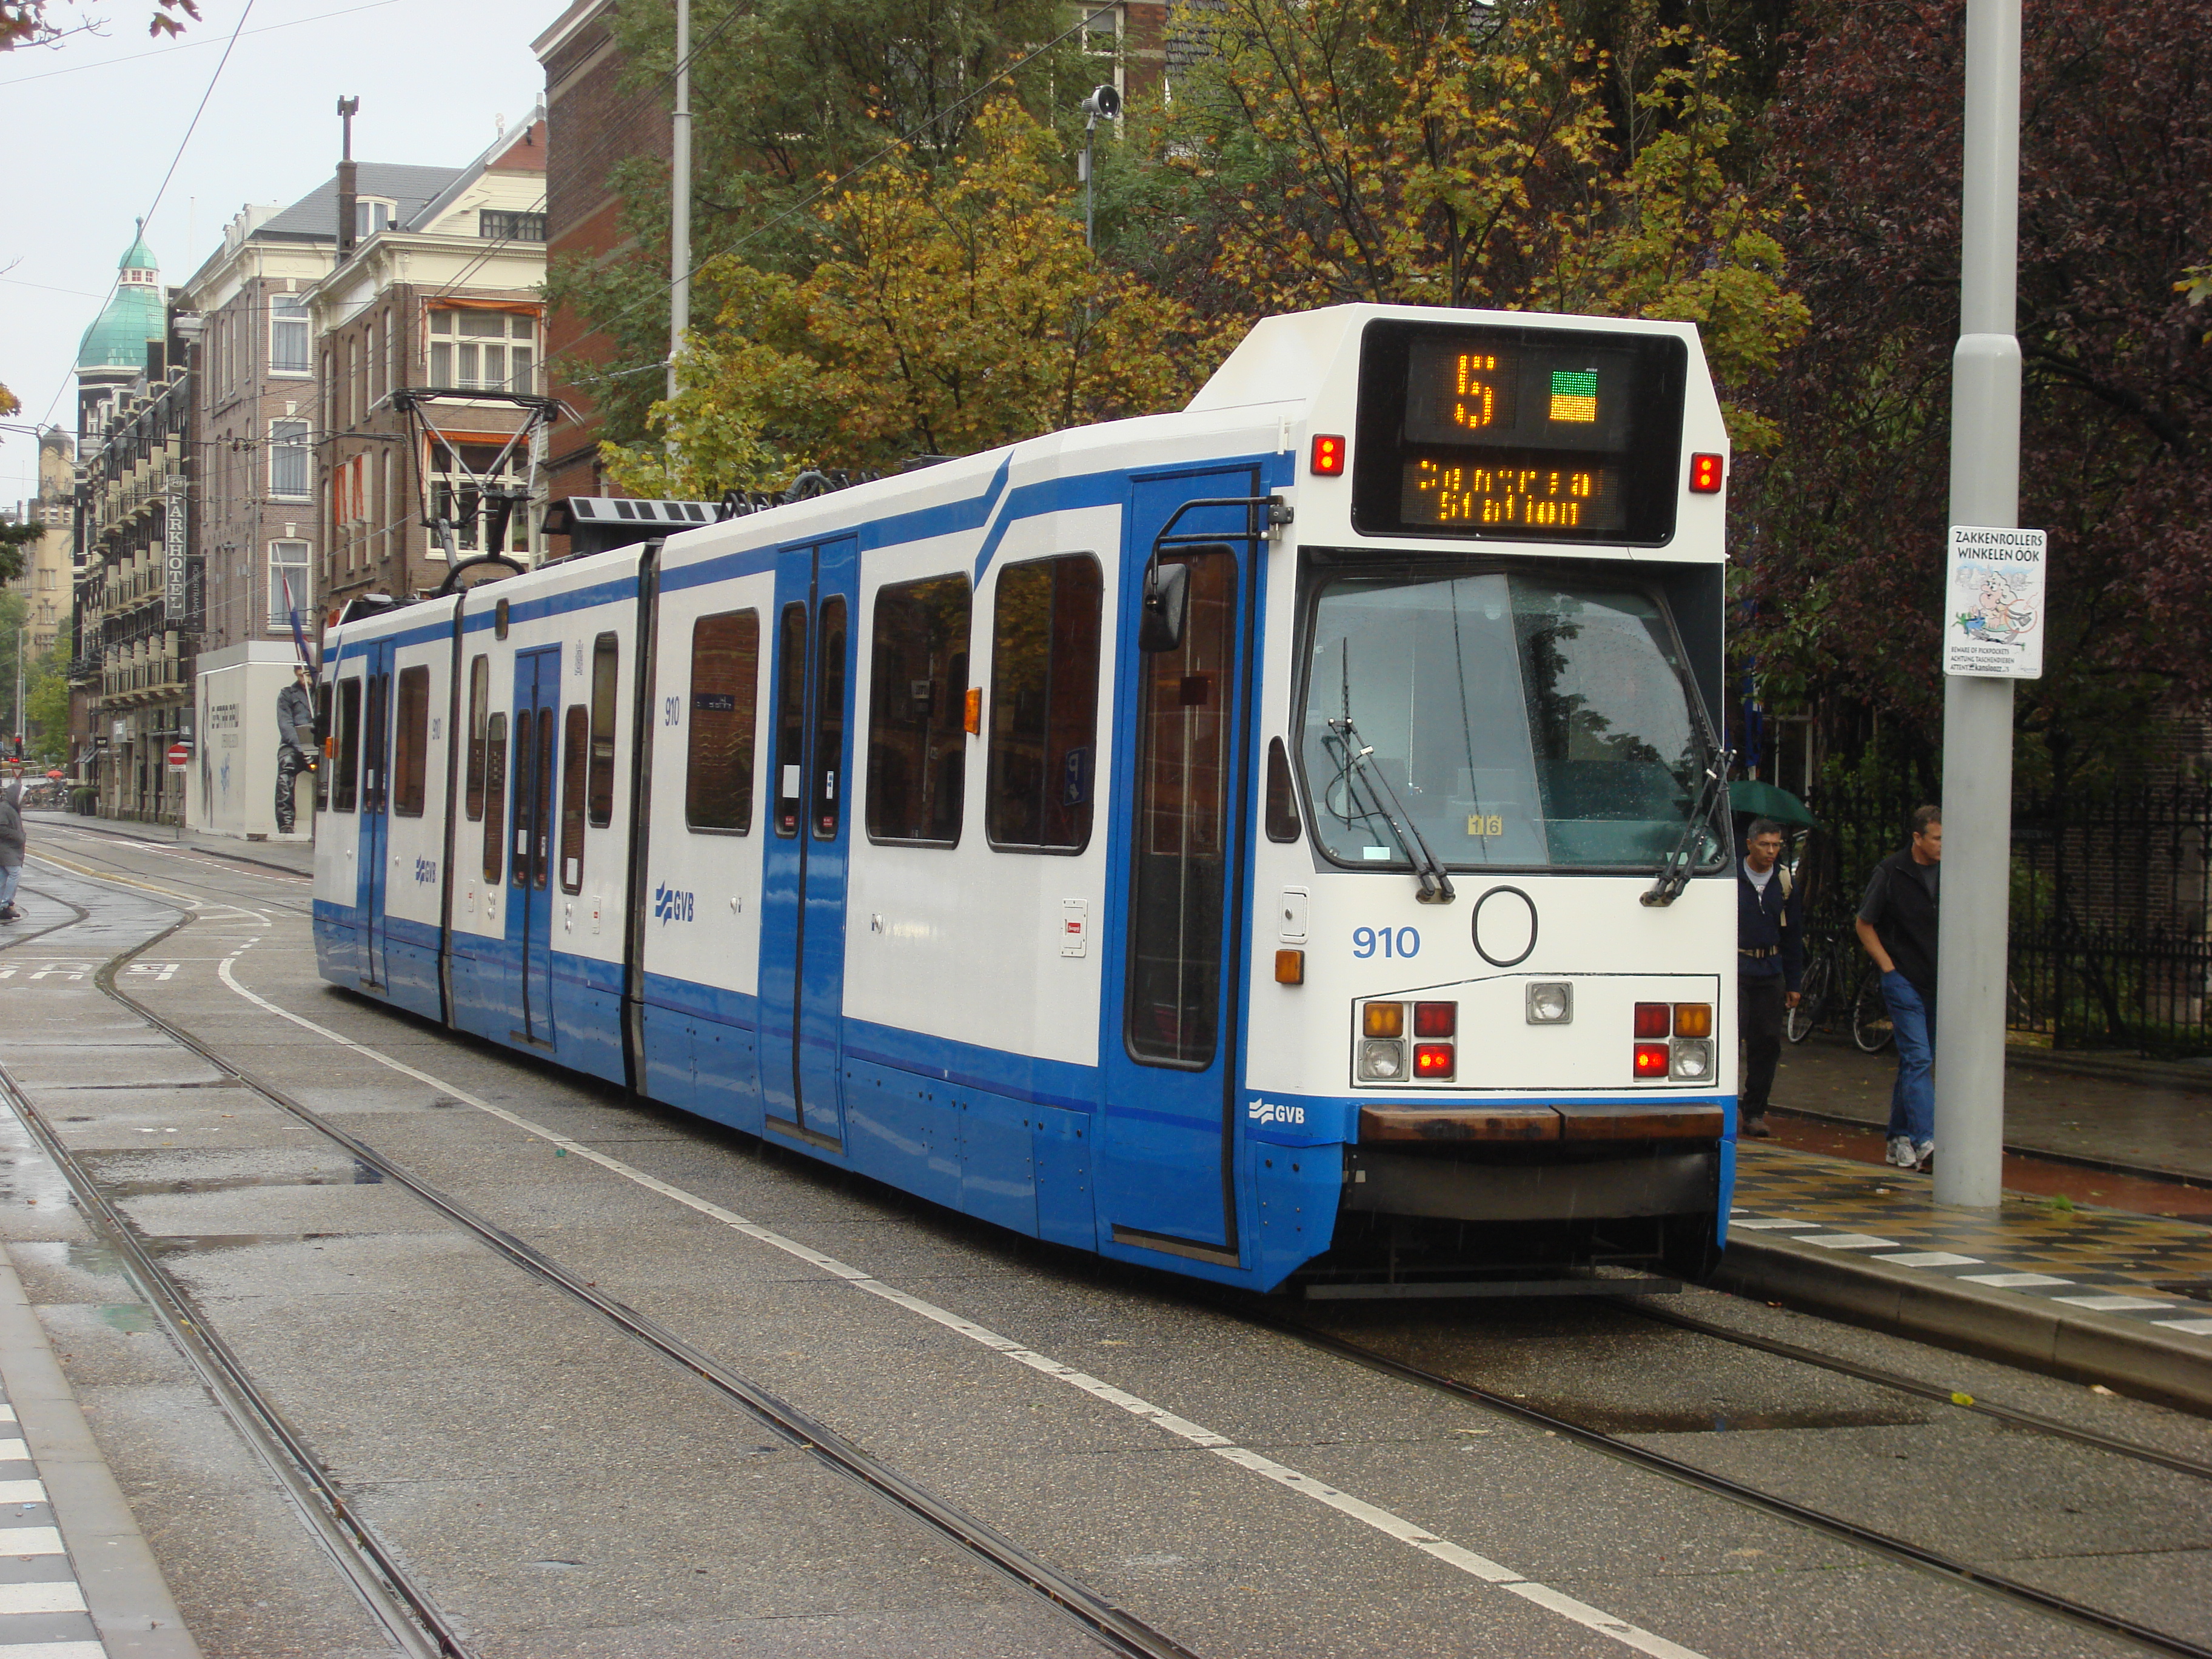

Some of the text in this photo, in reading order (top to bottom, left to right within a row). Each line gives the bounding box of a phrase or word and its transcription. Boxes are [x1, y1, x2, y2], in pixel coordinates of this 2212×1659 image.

[1454, 354, 1496, 428] 5
[1956, 531, 2043, 546] ZAKKENROLLERS
[169, 493, 184, 608] PARKHOTEL
[1958, 547, 2040, 561] WINKELEN ÓÓK
[665, 695, 680, 726] 910
[432, 718, 441, 740] 910
[1472, 819, 1499, 834] 16
[425, 861, 436, 883] GVB
[674, 890, 694, 922] GVB
[1353, 925, 1421, 959] 910
[1275, 1105, 1305, 1124] GVB
